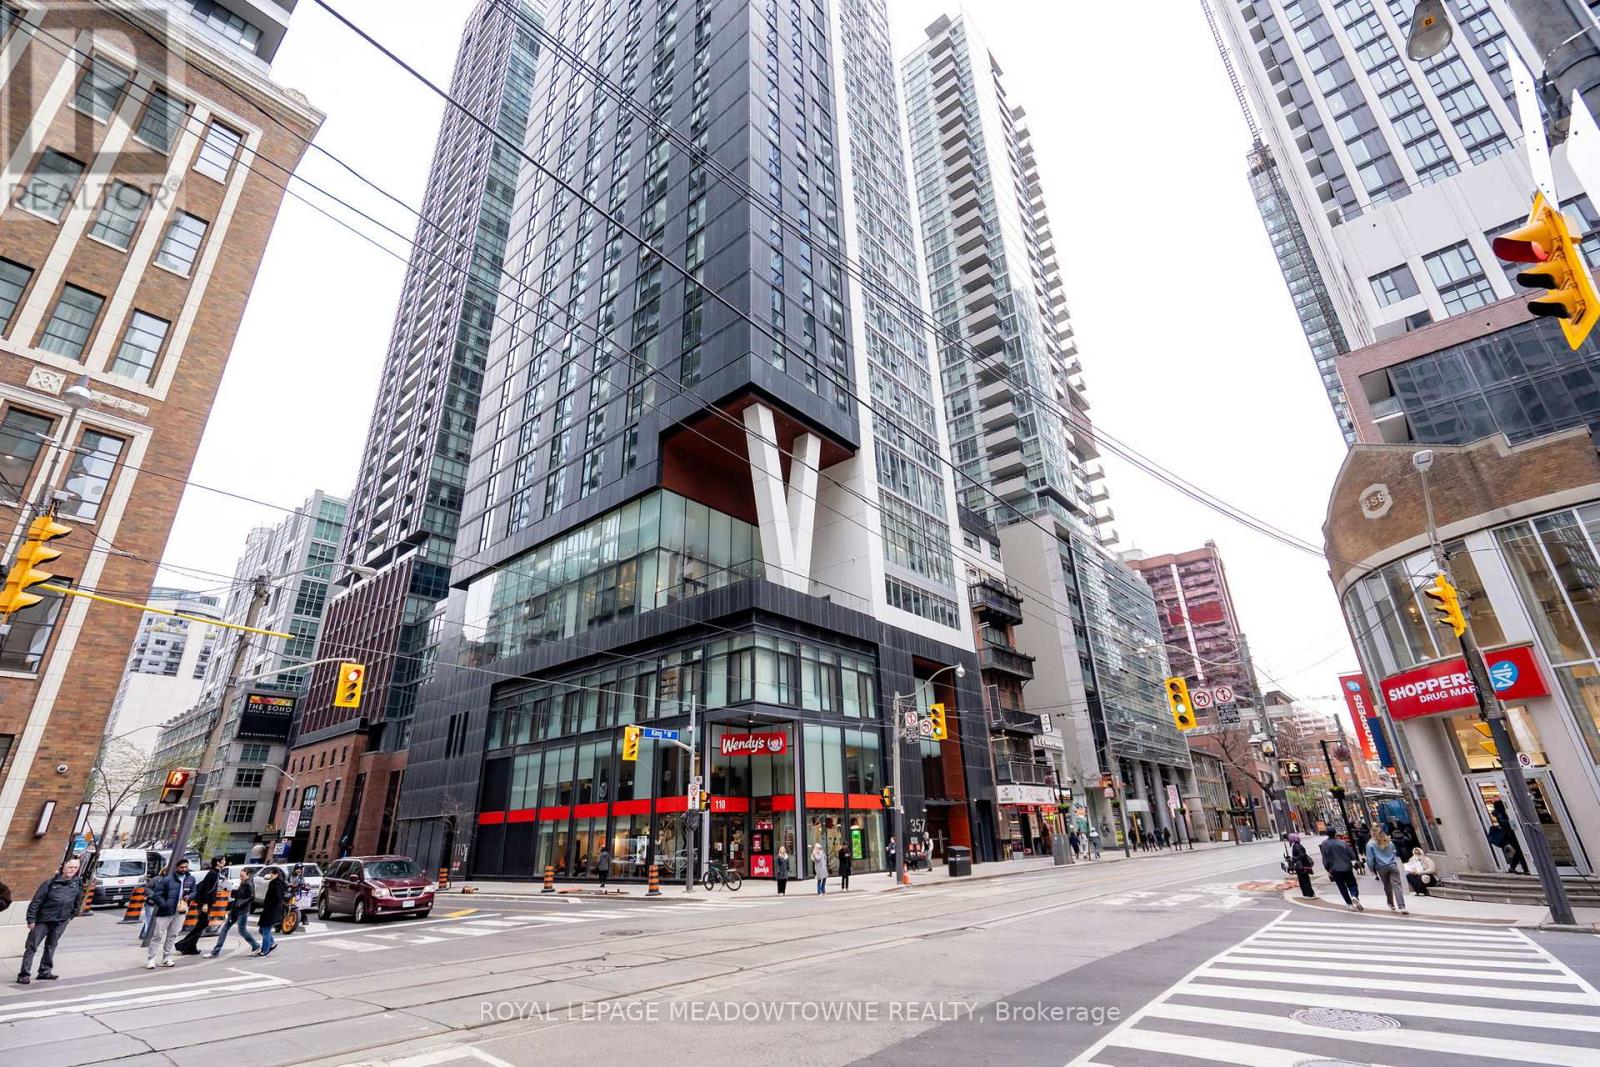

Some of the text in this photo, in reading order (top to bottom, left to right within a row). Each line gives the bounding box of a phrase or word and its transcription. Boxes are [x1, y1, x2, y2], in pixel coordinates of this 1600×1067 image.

[1420, 686, 1477, 703] DRUG MAR
[248, 703, 264, 711] THE
[267, 705, 292, 713] SOHO
[722, 735, 765, 754] Wendy's
[715, 800, 726, 809] 110
[910, 819, 926, 832] 357
